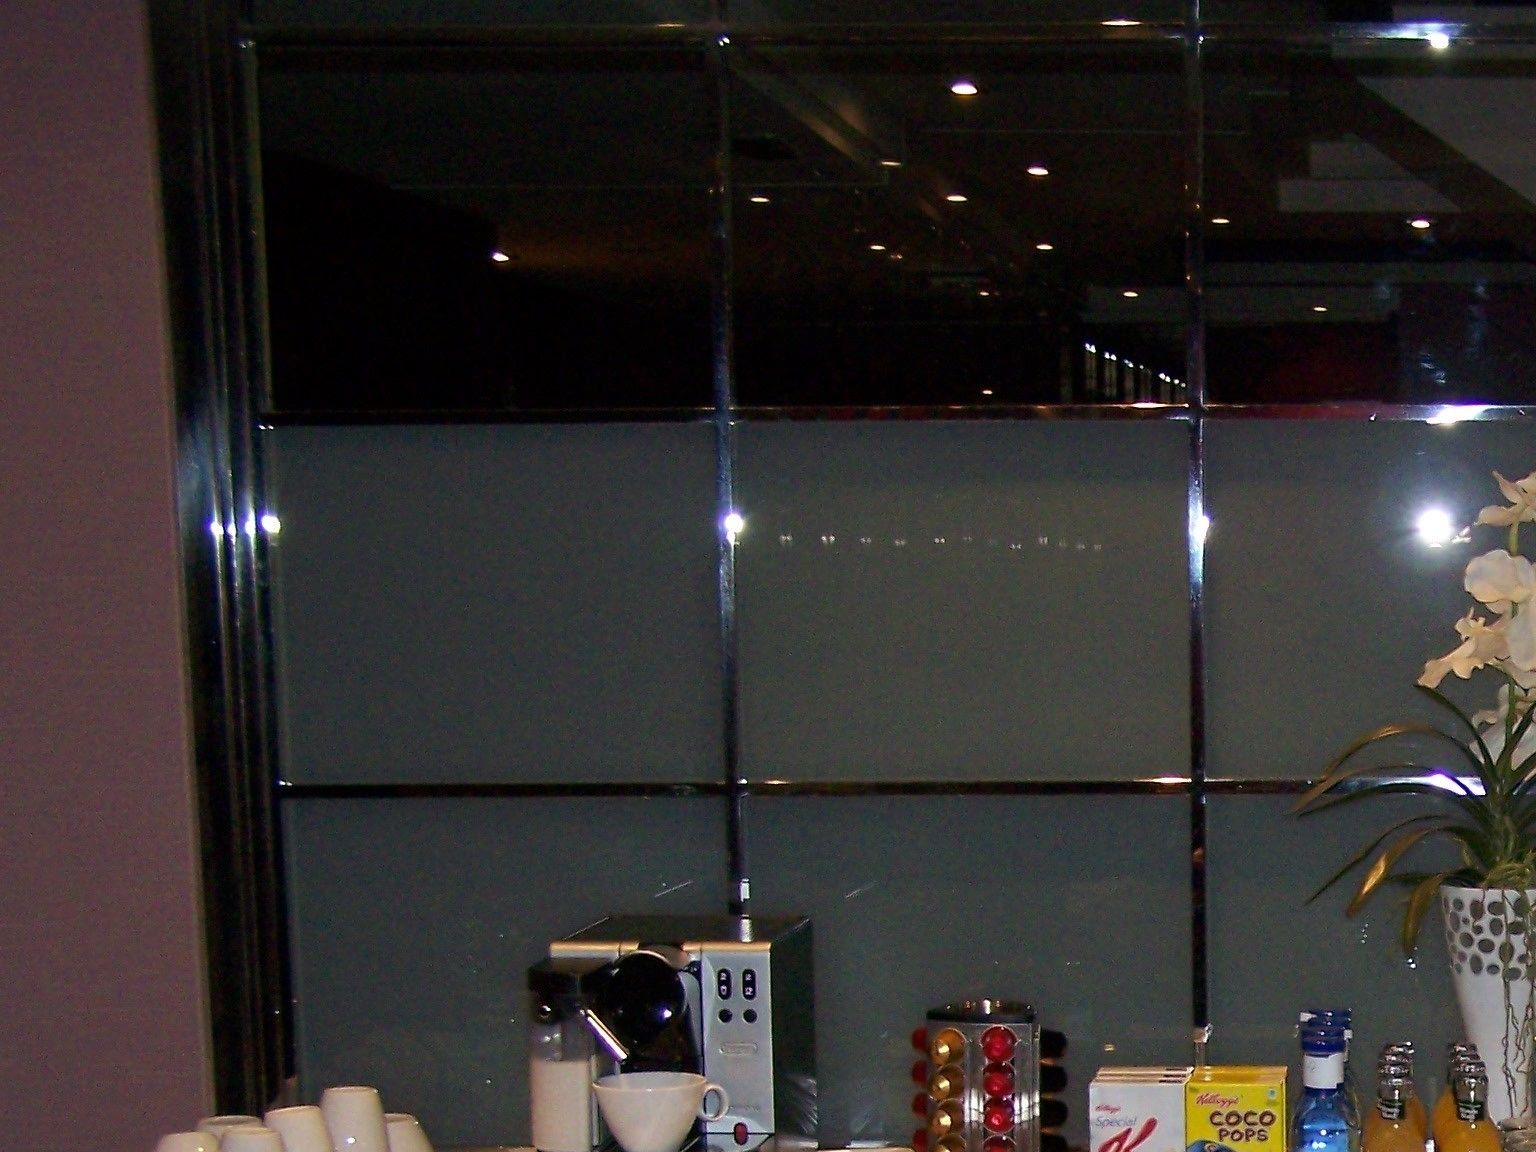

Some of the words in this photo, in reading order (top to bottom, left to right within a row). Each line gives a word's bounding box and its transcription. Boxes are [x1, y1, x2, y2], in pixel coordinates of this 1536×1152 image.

[1096, 1116, 1137, 1128] Special
[1210, 1110, 1277, 1126] COCO
[1218, 1128, 1269, 1142] POPS
